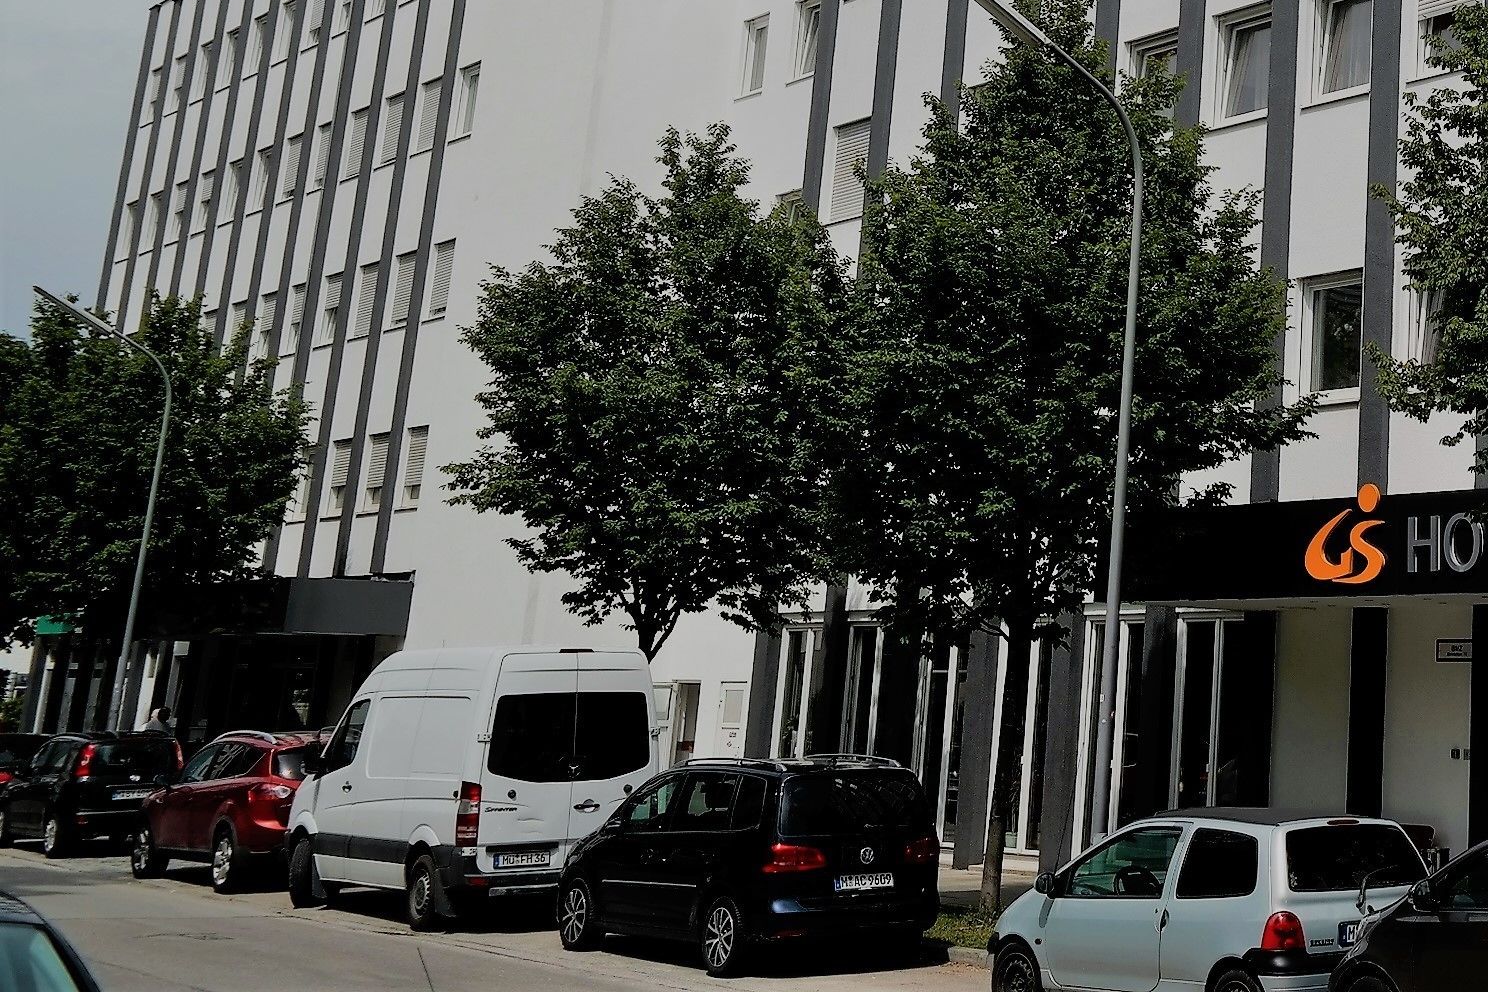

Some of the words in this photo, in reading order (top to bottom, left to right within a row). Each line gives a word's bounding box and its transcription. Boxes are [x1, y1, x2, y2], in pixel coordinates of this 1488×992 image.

[520, 853, 533, 864] FH
[534, 853, 546, 863] 36
[854, 875, 867, 886] AC
[867, 873, 892, 886] 9609
